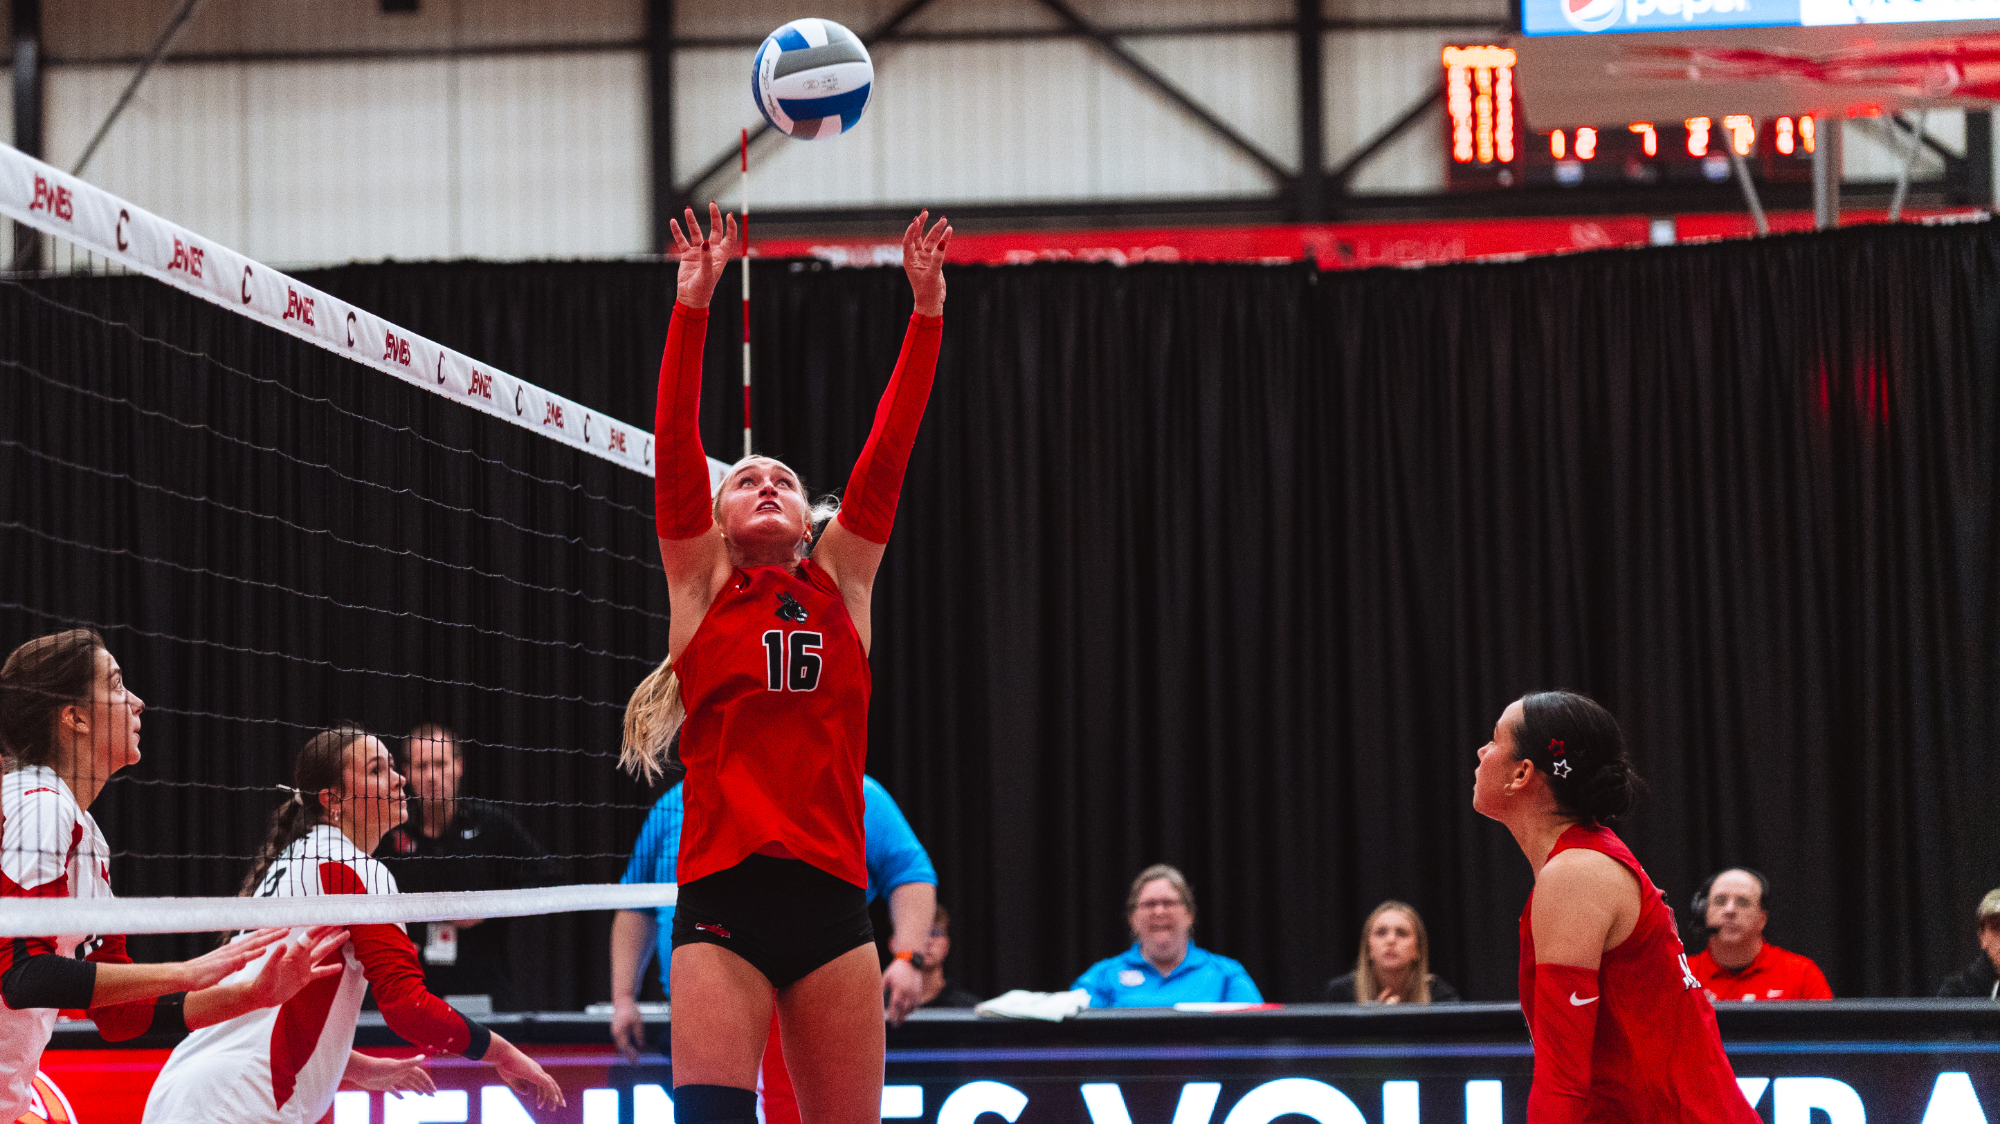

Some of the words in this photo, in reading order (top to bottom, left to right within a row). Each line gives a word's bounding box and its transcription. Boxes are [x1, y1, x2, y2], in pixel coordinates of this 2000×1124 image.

[117, 209, 129, 252] C
[242, 265, 253, 305] C
[347, 312, 357, 348] C
[437, 350, 446, 385] C
[515, 385, 524, 417] C
[583, 413, 591, 444] C
[762, 629, 822, 692] 16
